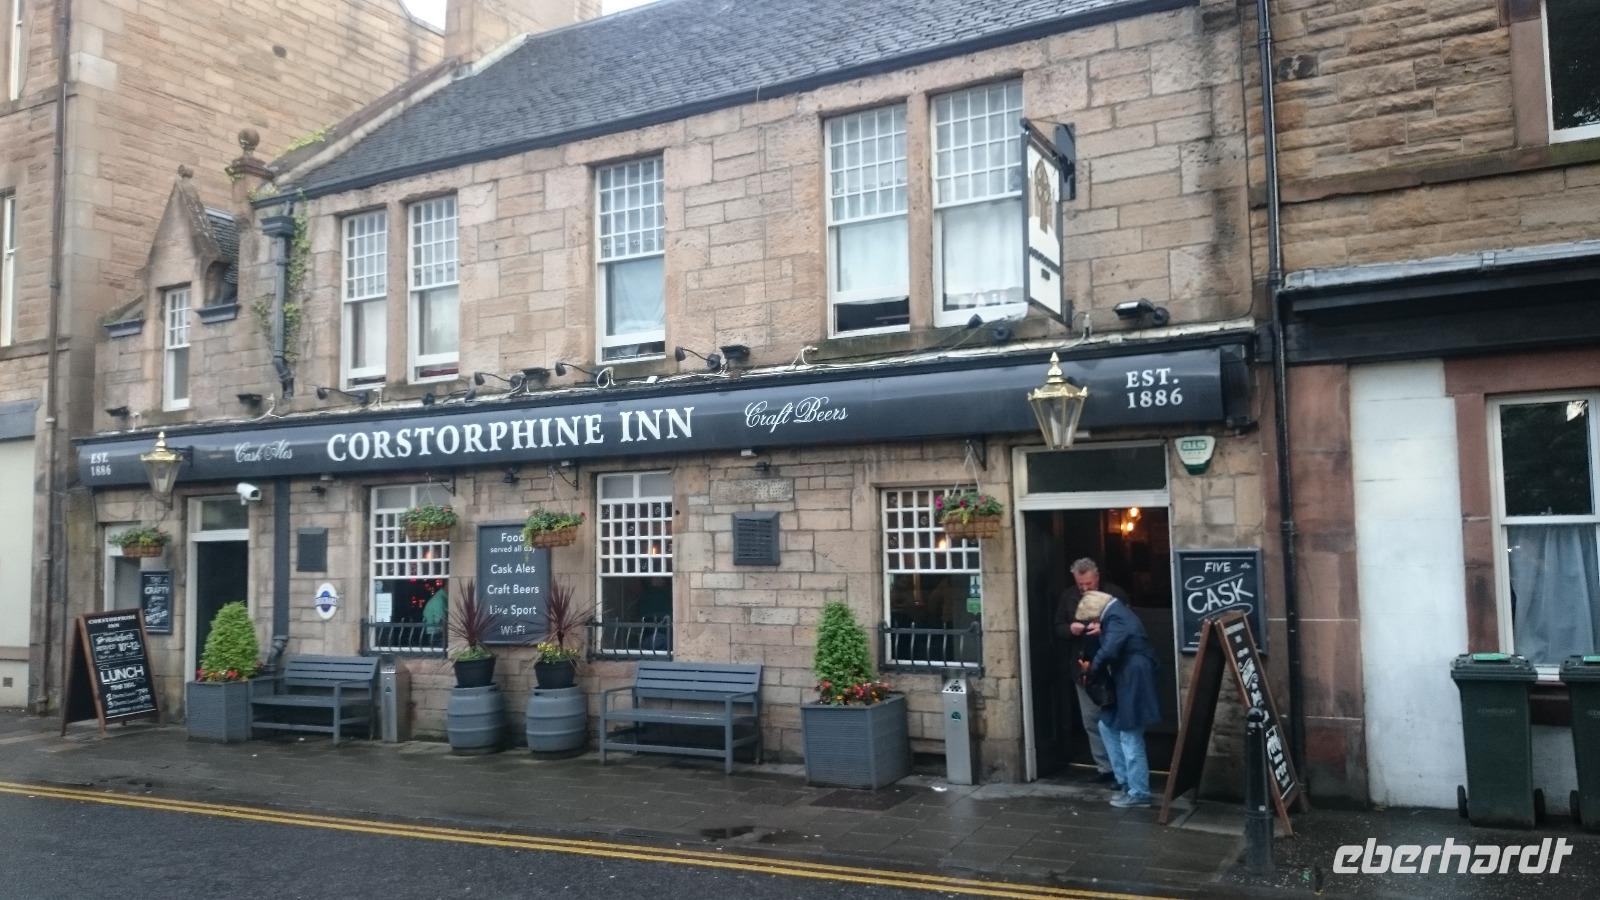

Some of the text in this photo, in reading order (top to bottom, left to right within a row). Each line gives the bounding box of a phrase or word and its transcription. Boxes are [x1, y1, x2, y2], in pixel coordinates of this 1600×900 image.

[1125, 367, 1179, 388] EST.
[1127, 388, 1183, 409] 1886
[744, 396, 848, 434] Craft Beers
[326, 406, 695, 462] CORSTORPHINE INN
[235, 439, 293, 463] Cask Ales
[91, 465, 112, 476] 1886
[490, 545, 512, 553] served
[514, 544, 522, 553] all
[490, 563, 536, 574] Cask Ales
[1204, 561, 1232, 573] FIVE
[487, 584, 540, 595] Craft Beers
[1187, 578, 1254, 614] CASK
[489, 604, 537, 617] Live Sport
[500, 625, 526, 635] Wi-Fi
[100, 665, 145, 683] LUNCH
